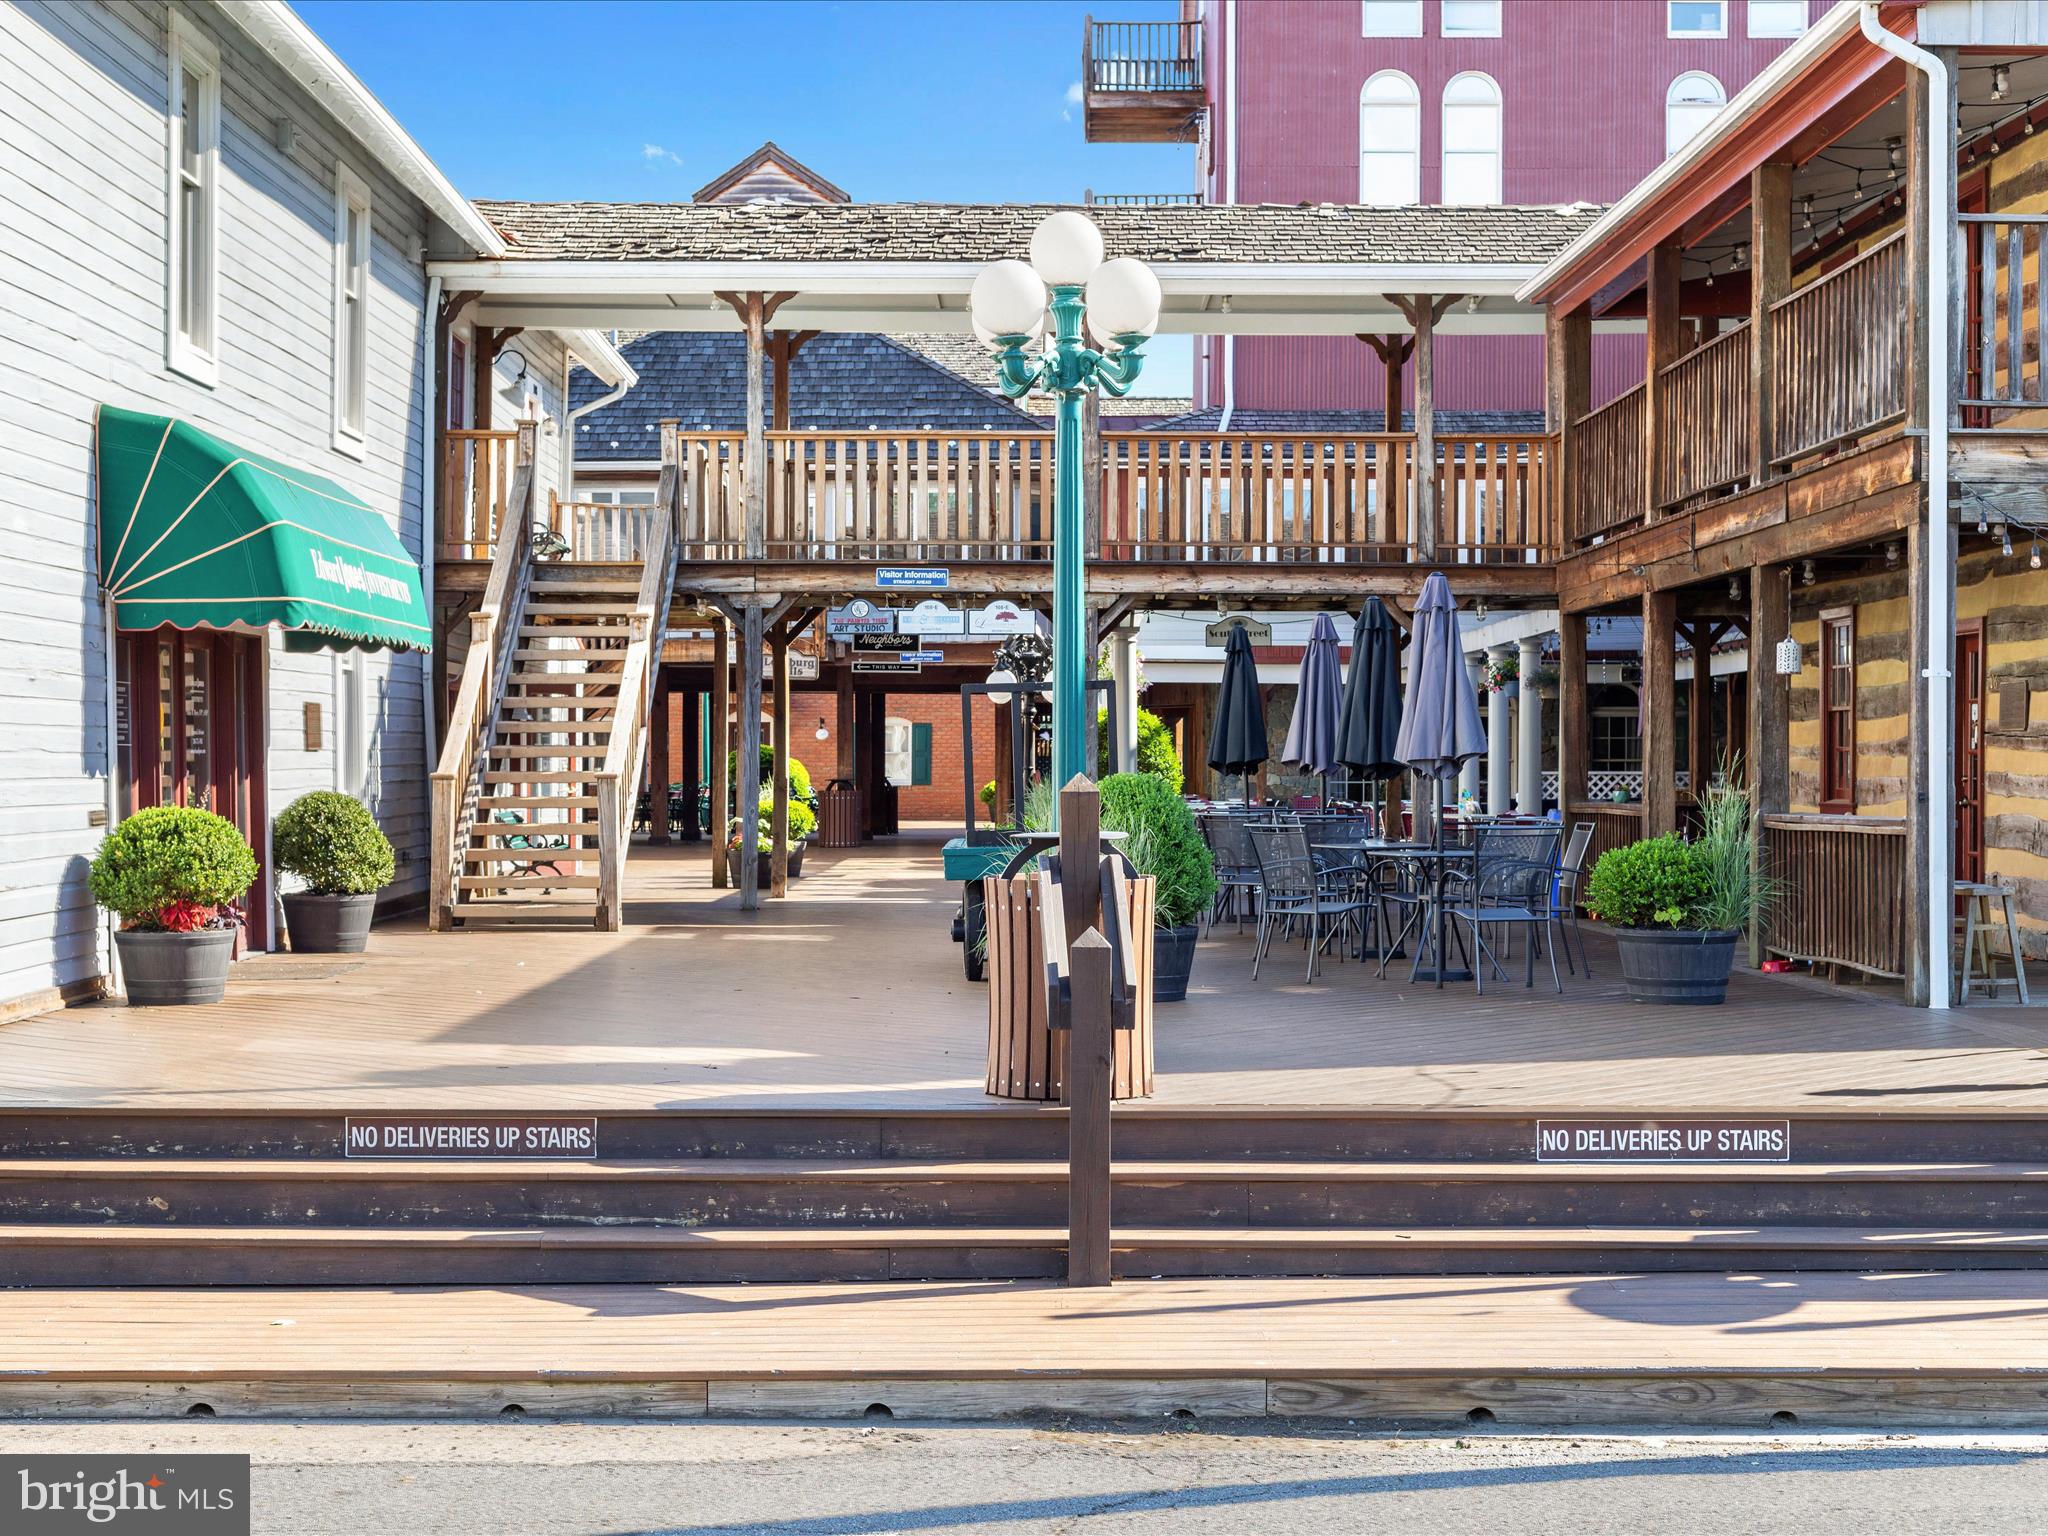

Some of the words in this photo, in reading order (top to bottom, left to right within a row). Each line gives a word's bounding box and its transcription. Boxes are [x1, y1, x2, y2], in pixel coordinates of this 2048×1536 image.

[879, 570, 903, 578] Visitor
[904, 570, 946, 579] Information
[834, 624, 849, 632] ART
[854, 624, 886, 632] STUDIO
[859, 633, 913, 650] Neighbors
[351, 1126, 378, 1148] NO
[384, 1126, 490, 1148] DELIVERIES
[495, 1126, 520, 1148] UP
[525, 1126, 591, 1149] STAIRS
[1542, 1129, 1569, 1151] NO
[1575, 1129, 1681, 1151] DELIVERIES
[1687, 1129, 1712, 1151] UP
[1717, 1129, 1783, 1151] STAIRS
